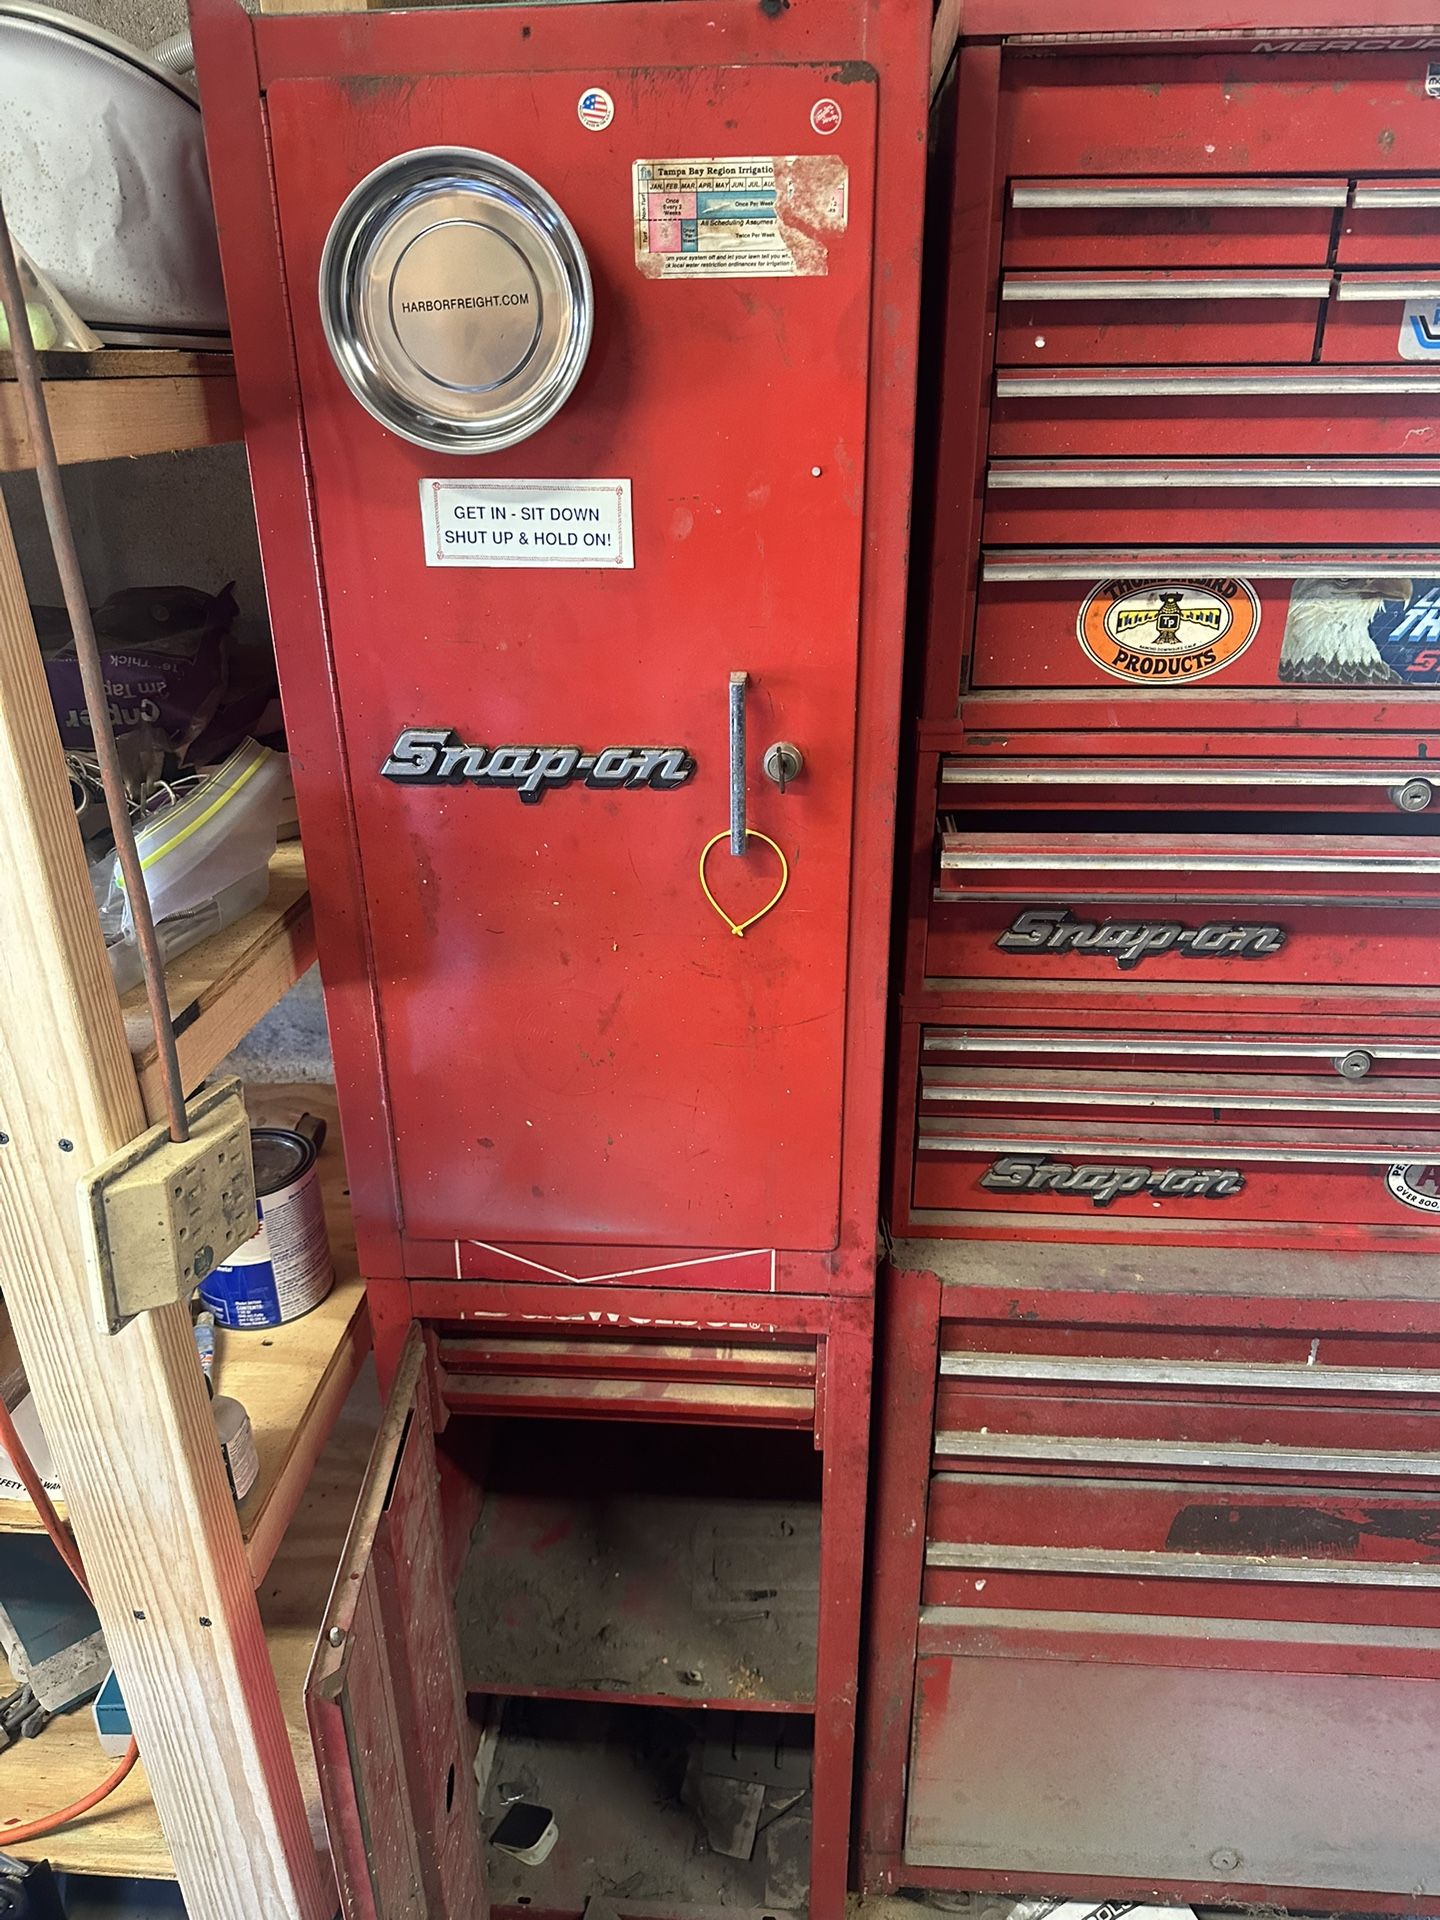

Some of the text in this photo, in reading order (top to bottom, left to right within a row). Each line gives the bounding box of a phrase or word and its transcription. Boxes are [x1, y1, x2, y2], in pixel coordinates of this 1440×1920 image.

[658, 167, 686, 177] Tampa
[689, 166, 704, 176] Bay
[707, 165, 736, 175] Region
[402, 293, 529, 313] HARBORFREIGHT.COM
[454, 506, 486, 520] GET
[491, 507, 506, 520] IN
[521, 508, 545, 520] SIT
[550, 508, 600, 521] DOWN
[445, 530, 612, 546] SHUT UP & HOLD ON!
[110, 655, 151, 668] Thick
[1112, 648, 1217, 675] PRODUCTS
[380, 728, 694, 803] Snap-on
[996, 909, 1285, 970] Snap-on
[980, 1155, 1246, 1207] Snap-on
[1396, 1185, 1418, 1203] OVER
